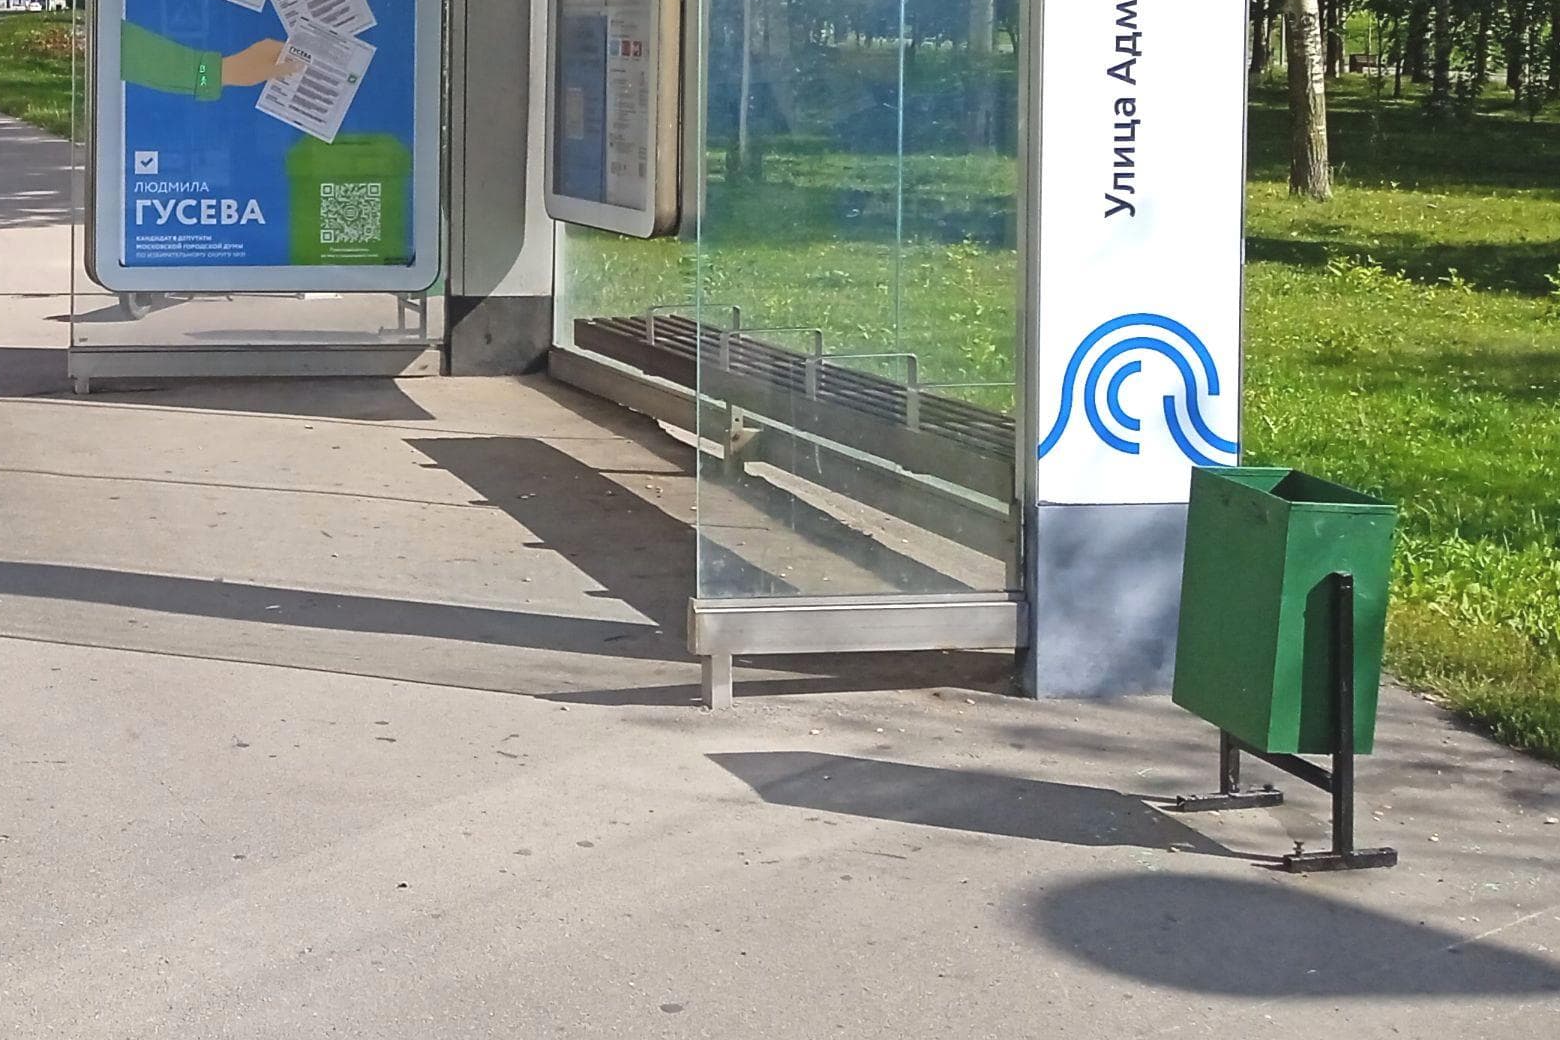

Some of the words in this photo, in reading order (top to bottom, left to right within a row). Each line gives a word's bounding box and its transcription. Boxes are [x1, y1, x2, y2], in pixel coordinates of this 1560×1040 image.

[1104, 97, 1141, 218] Улица
[134, 181, 210, 193] ЛЮДМИЛА
[135, 199, 266, 225] ГУСЕВА
